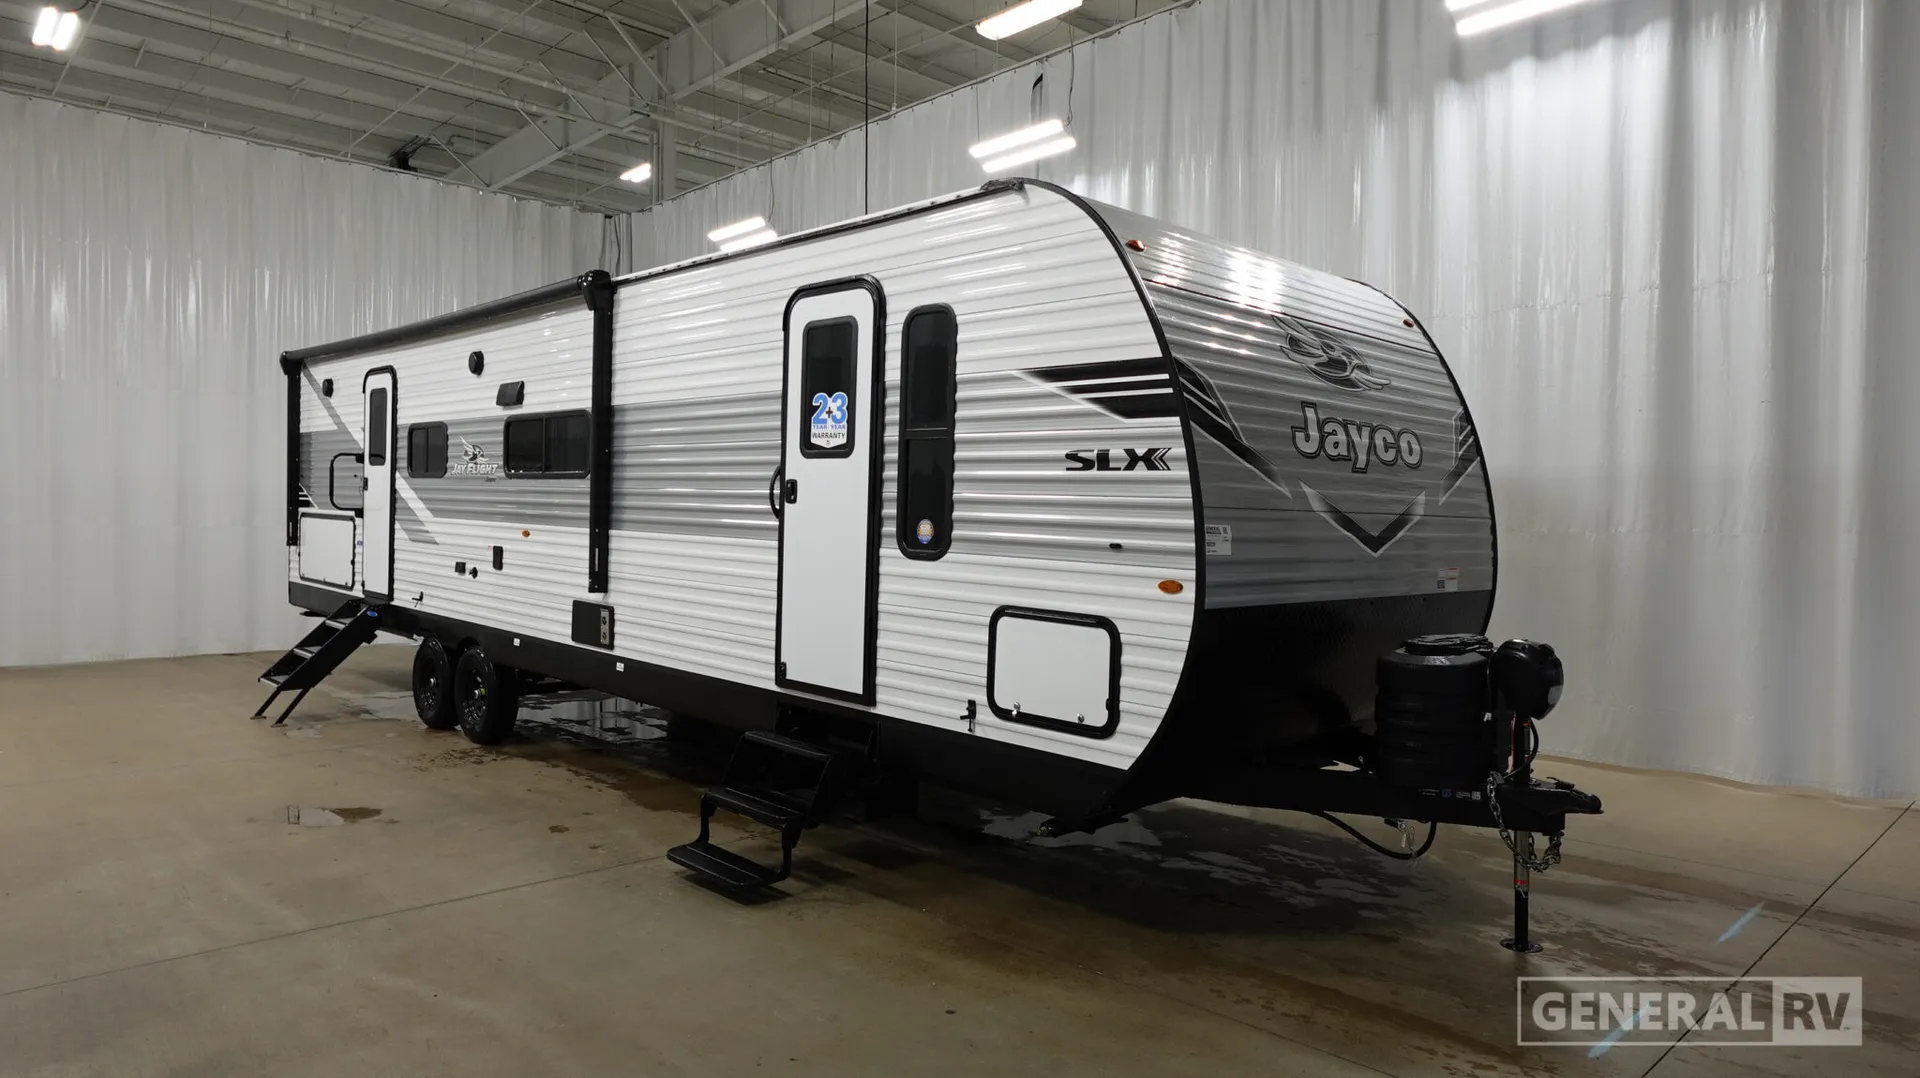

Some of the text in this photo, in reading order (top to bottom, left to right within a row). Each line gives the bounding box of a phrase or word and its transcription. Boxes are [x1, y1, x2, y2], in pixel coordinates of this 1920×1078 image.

[1291, 401, 1423, 473] Jayco
[451, 462, 499, 475] JAY FLIGHT
[1065, 448, 1172, 471] SLX
